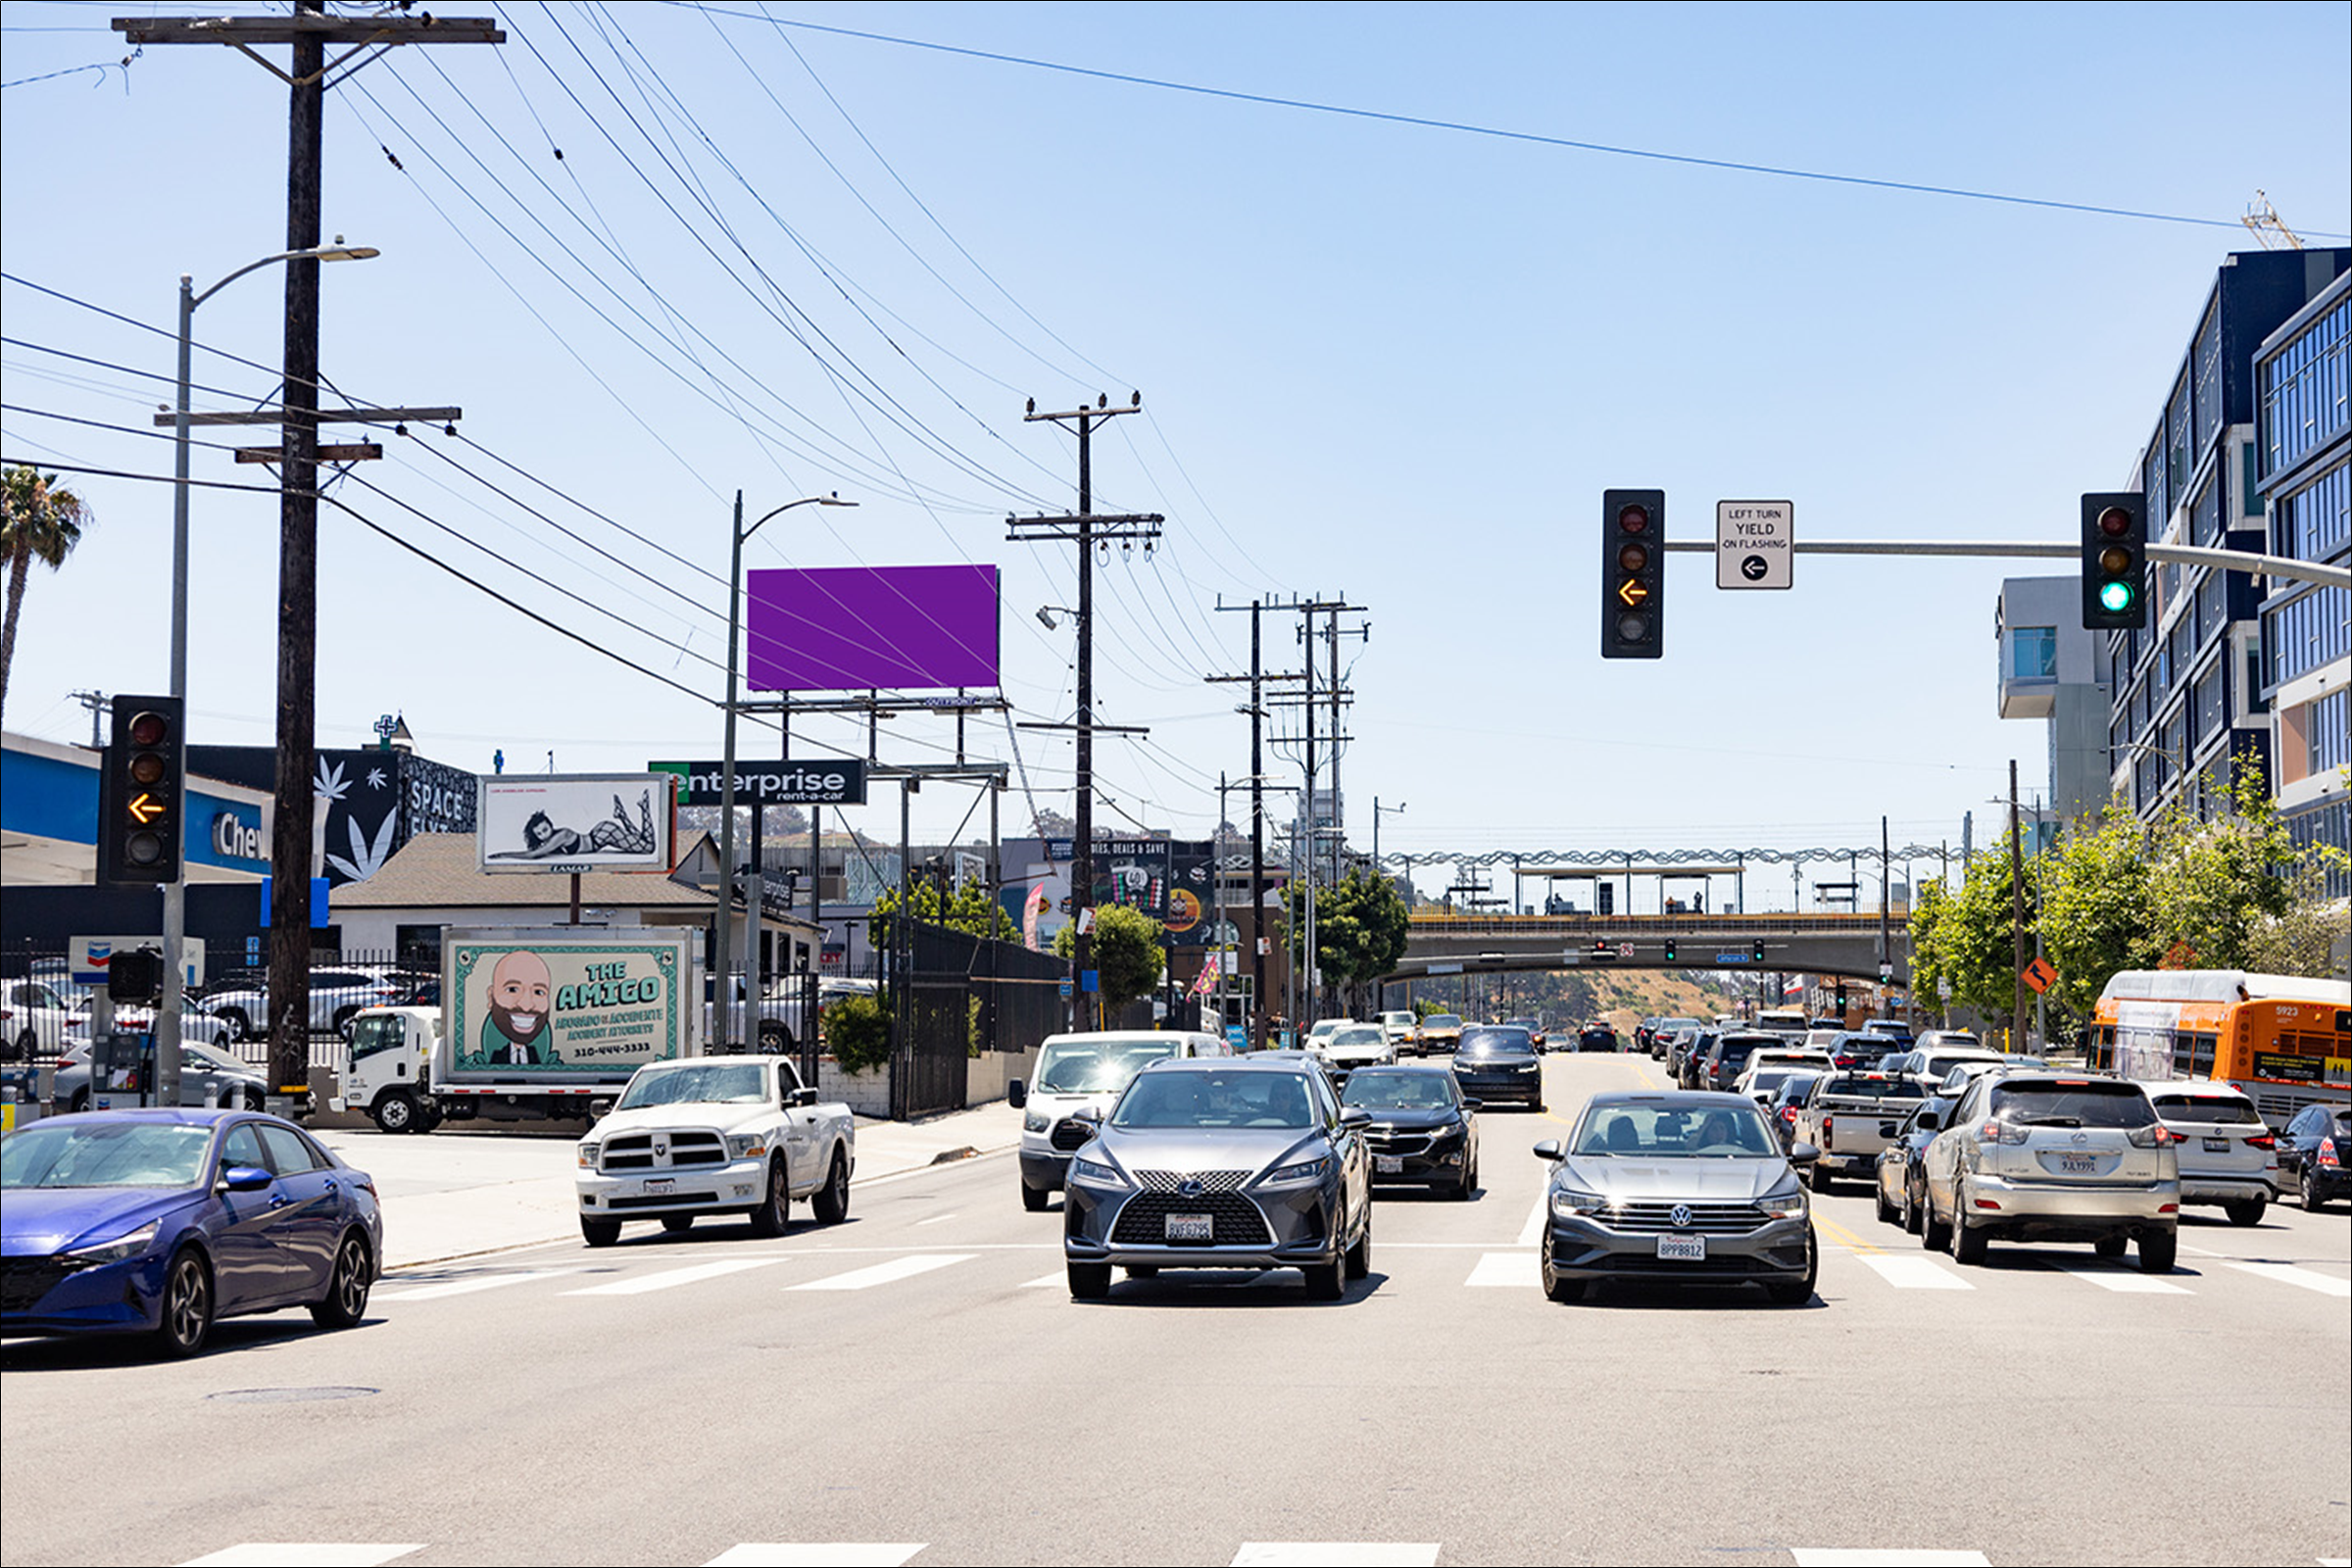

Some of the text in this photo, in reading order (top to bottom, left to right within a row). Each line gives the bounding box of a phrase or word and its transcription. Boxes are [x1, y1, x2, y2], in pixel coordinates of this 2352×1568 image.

[1729, 510, 1782, 519] LEFT TURN
[1736, 522, 1775, 535] YIELD
[1723, 539, 1787, 549] ON FLASHING
[412, 780, 463, 821] SPACE
[776, 791, 846, 802] rent-a-car
[219, 811, 265, 859] Chev
[1112, 844, 1135, 855] DEALS
[1146, 843, 1166, 855] SAVE
[585, 961, 627, 982] THE
[556, 976, 661, 1011] AMIGO
[2276, 1005, 2299, 1017] 5923
[574, 1042, 651, 1058] 310-444-3333
